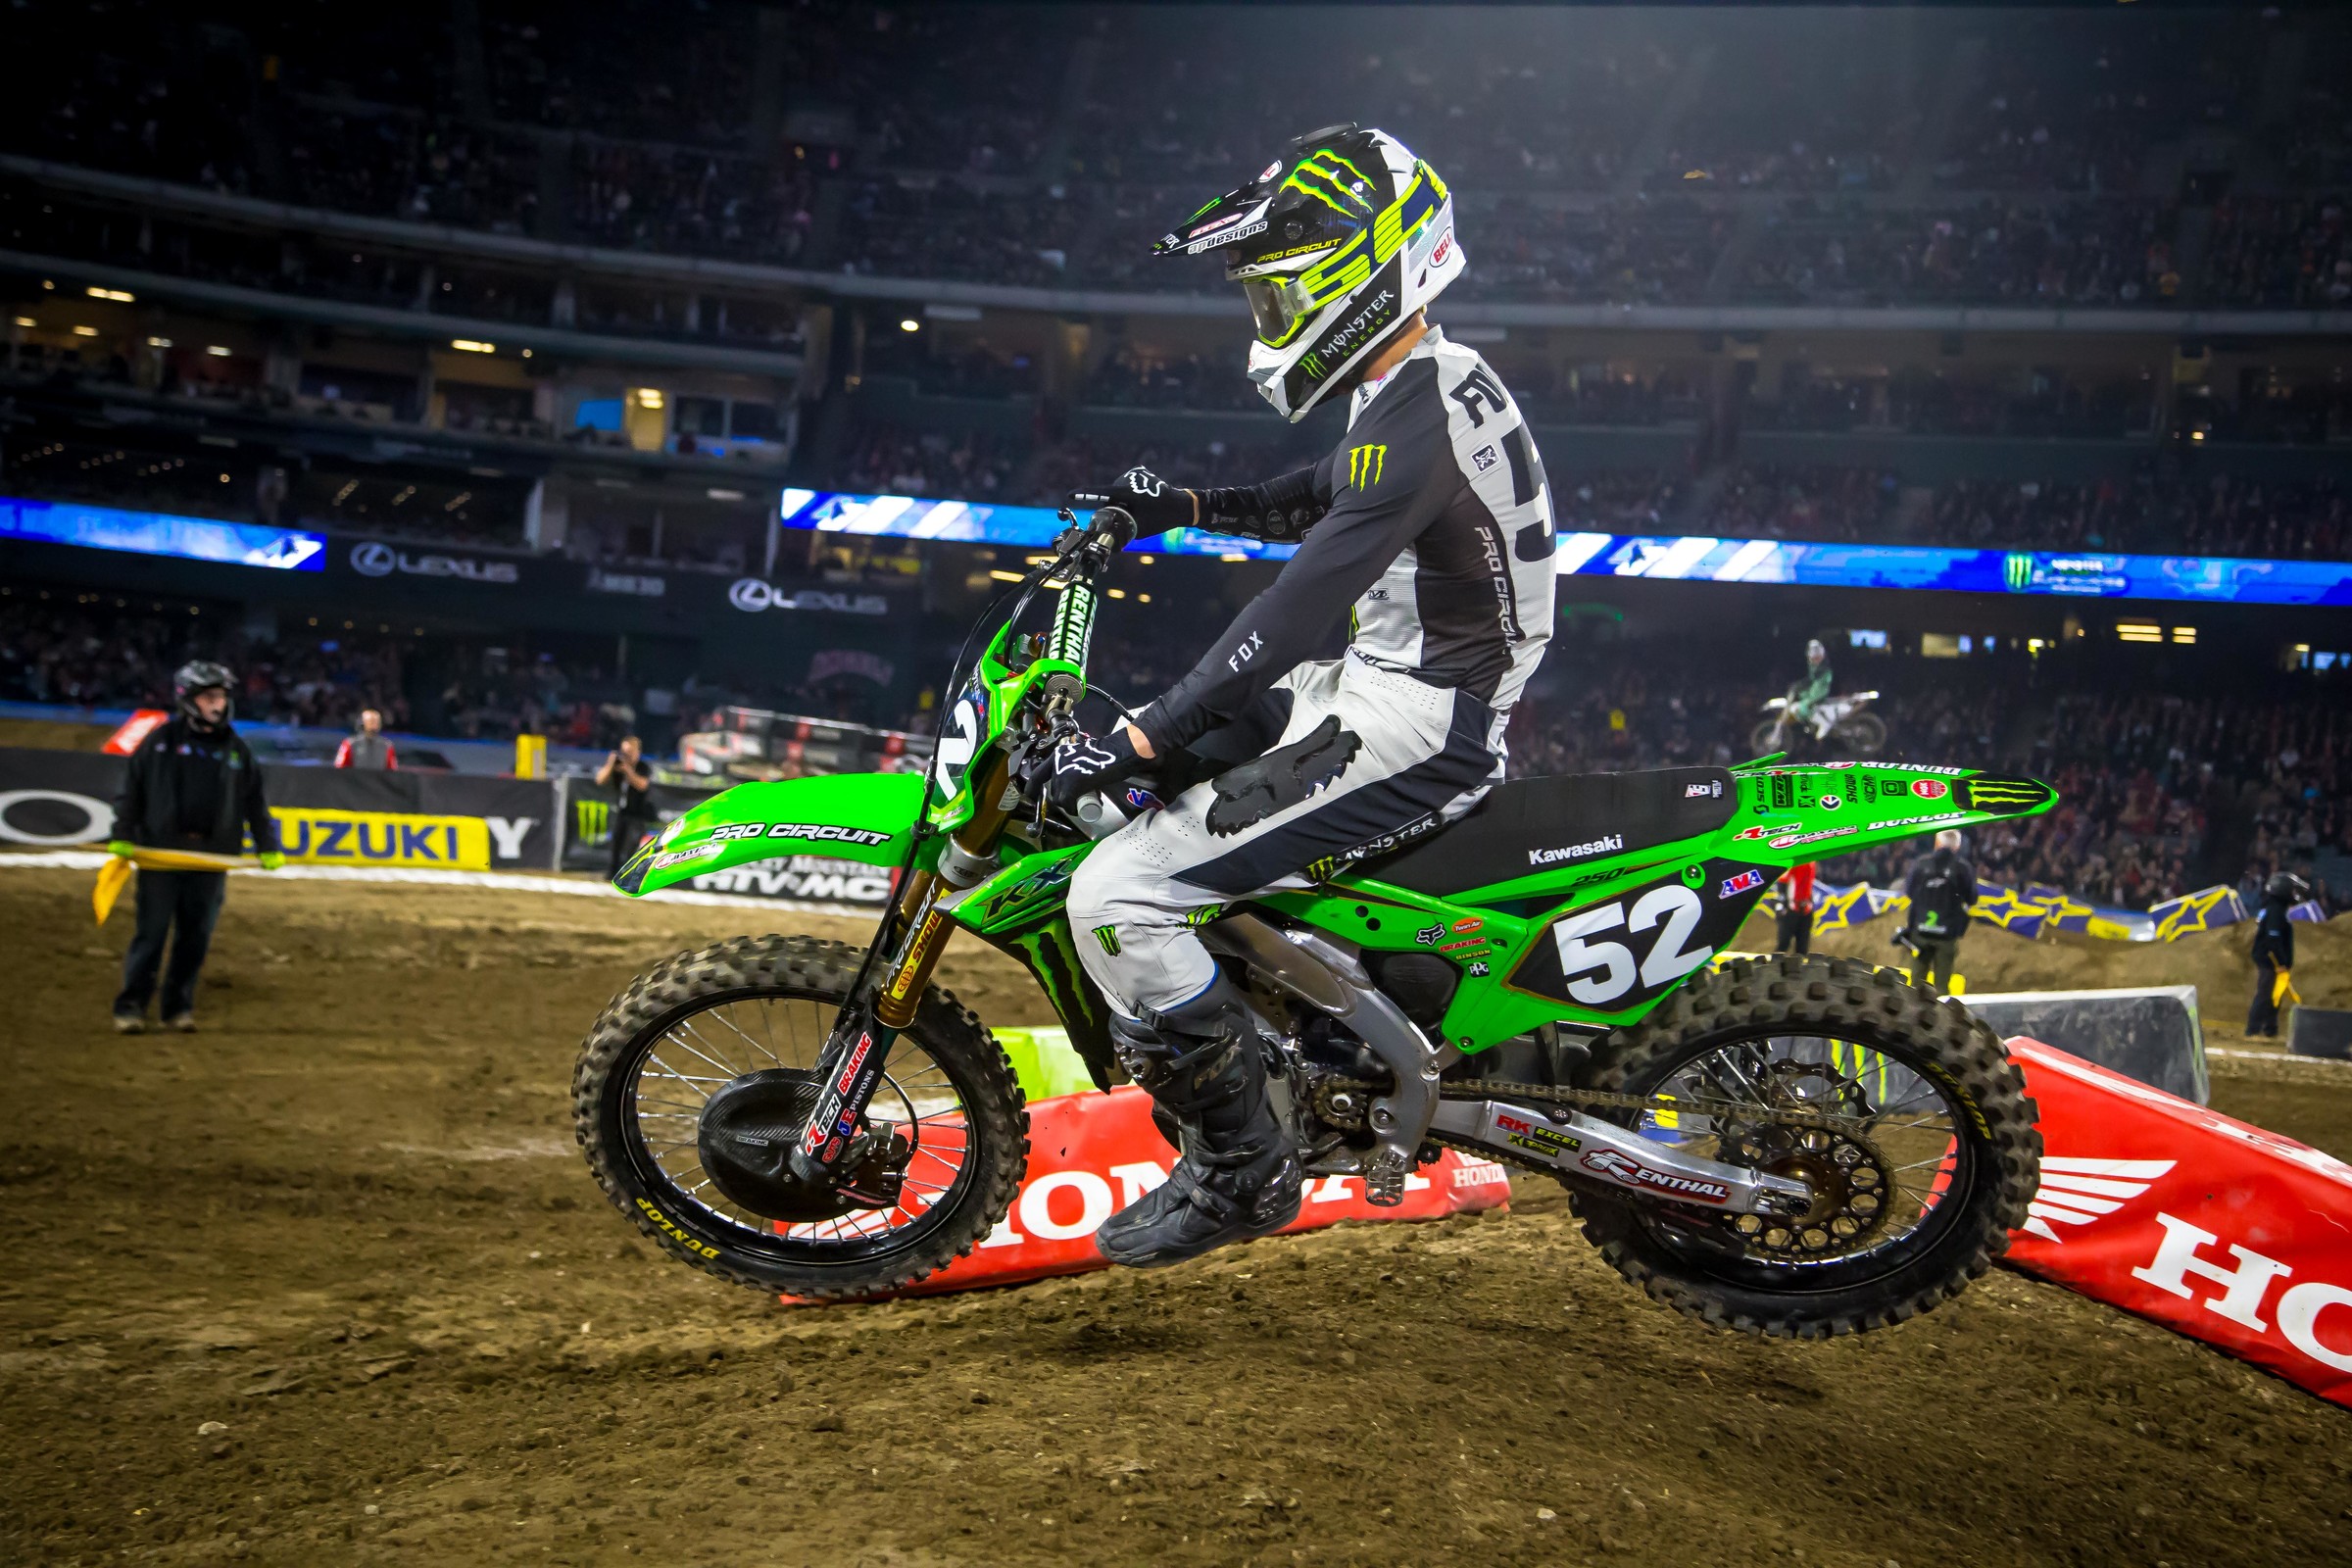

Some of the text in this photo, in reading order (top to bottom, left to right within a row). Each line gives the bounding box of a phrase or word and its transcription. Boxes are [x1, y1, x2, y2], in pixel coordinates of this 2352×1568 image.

[1256, 238, 1343, 264] PRO CIRCUIT
[1433, 233, 1452, 264] BELL
[1321, 290, 1395, 358] MONSTER
[1343, 309, 1391, 357] ENERGY
[1475, 526, 1503, 572] PRO
[396, 552, 519, 583] LEXUS
[772, 589, 888, 615] LEXUS
[1228, 630, 1264, 673] FOX
[1843, 773, 1858, 805] SHOWA
[710, 823, 893, 846] PRO CIRCUIT
[1866, 811, 1968, 831] DUNLOP
[245, 817, 459, 860] UZUKI
[1335, 817, 1438, 863] MONSTER
[1529, 834, 1623, 865] Kawasaki
[1570, 867, 1626, 887] 250
[1720, 869, 1763, 898] AMA
[886, 876, 937, 988] PRO CIRCUIT
[912, 911, 941, 963] SHOW
[1440, 937, 1486, 953] BRAKING
[1553, 884, 1714, 1004] 52
[837, 1031, 872, 1097] BRAKING
[850, 1068, 875, 1111] PISTONS
[837, 1108, 858, 1136] JE
[1495, 1113, 1533, 1135] RK
[1536, 1127, 1580, 1148] EXCEL
[1583, 1151, 1728, 1198] RENTHAL
[635, 1197, 721, 1260] DUNLOP
